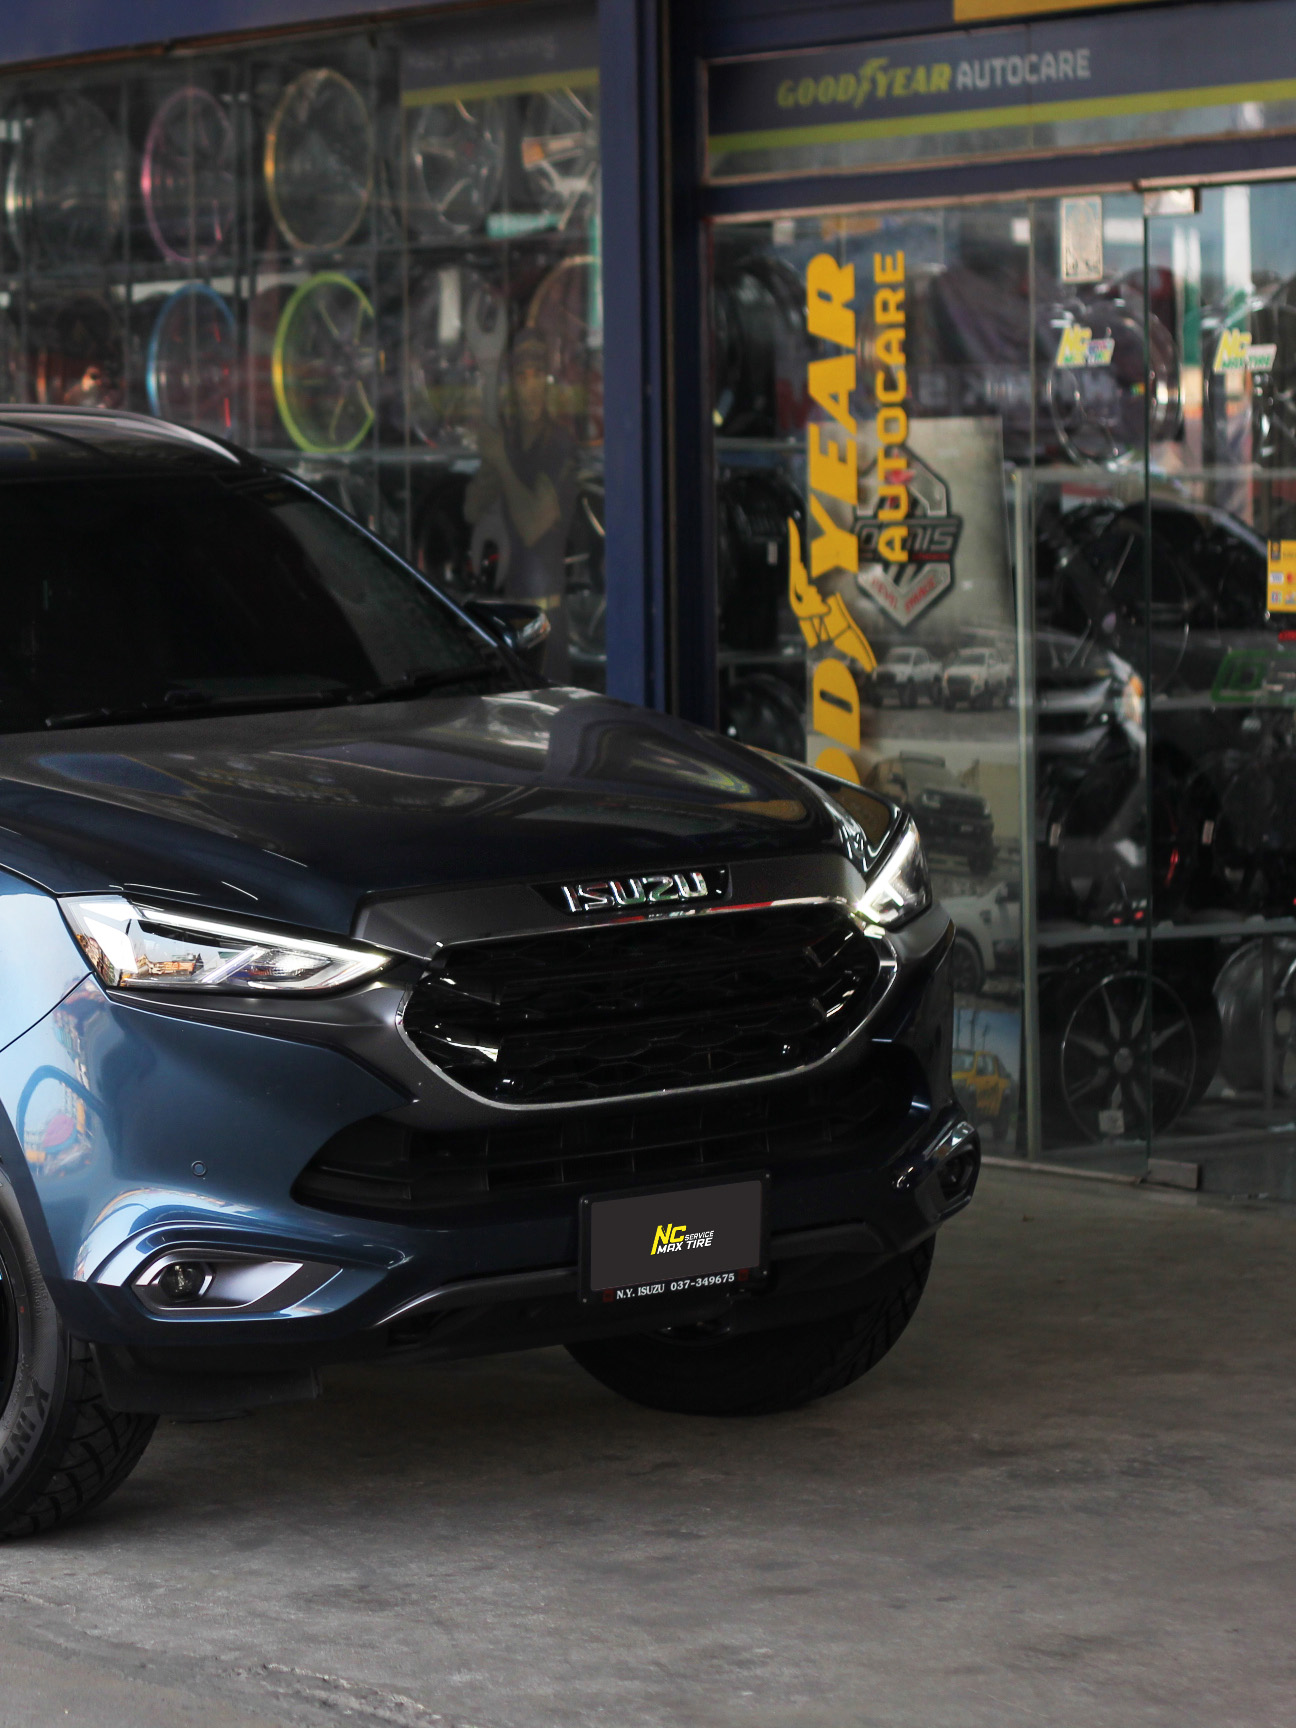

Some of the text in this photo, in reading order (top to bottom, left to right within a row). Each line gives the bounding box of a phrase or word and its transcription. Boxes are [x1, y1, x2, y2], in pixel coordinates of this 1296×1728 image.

[776, 47, 1092, 109] GOODYEAR AUTOCARE
[873, 251, 908, 563] AUTOCARE
[561, 871, 708, 913] ISUZU
[616, 1272, 736, 1300] N.Y. ISUZU 037-349675
